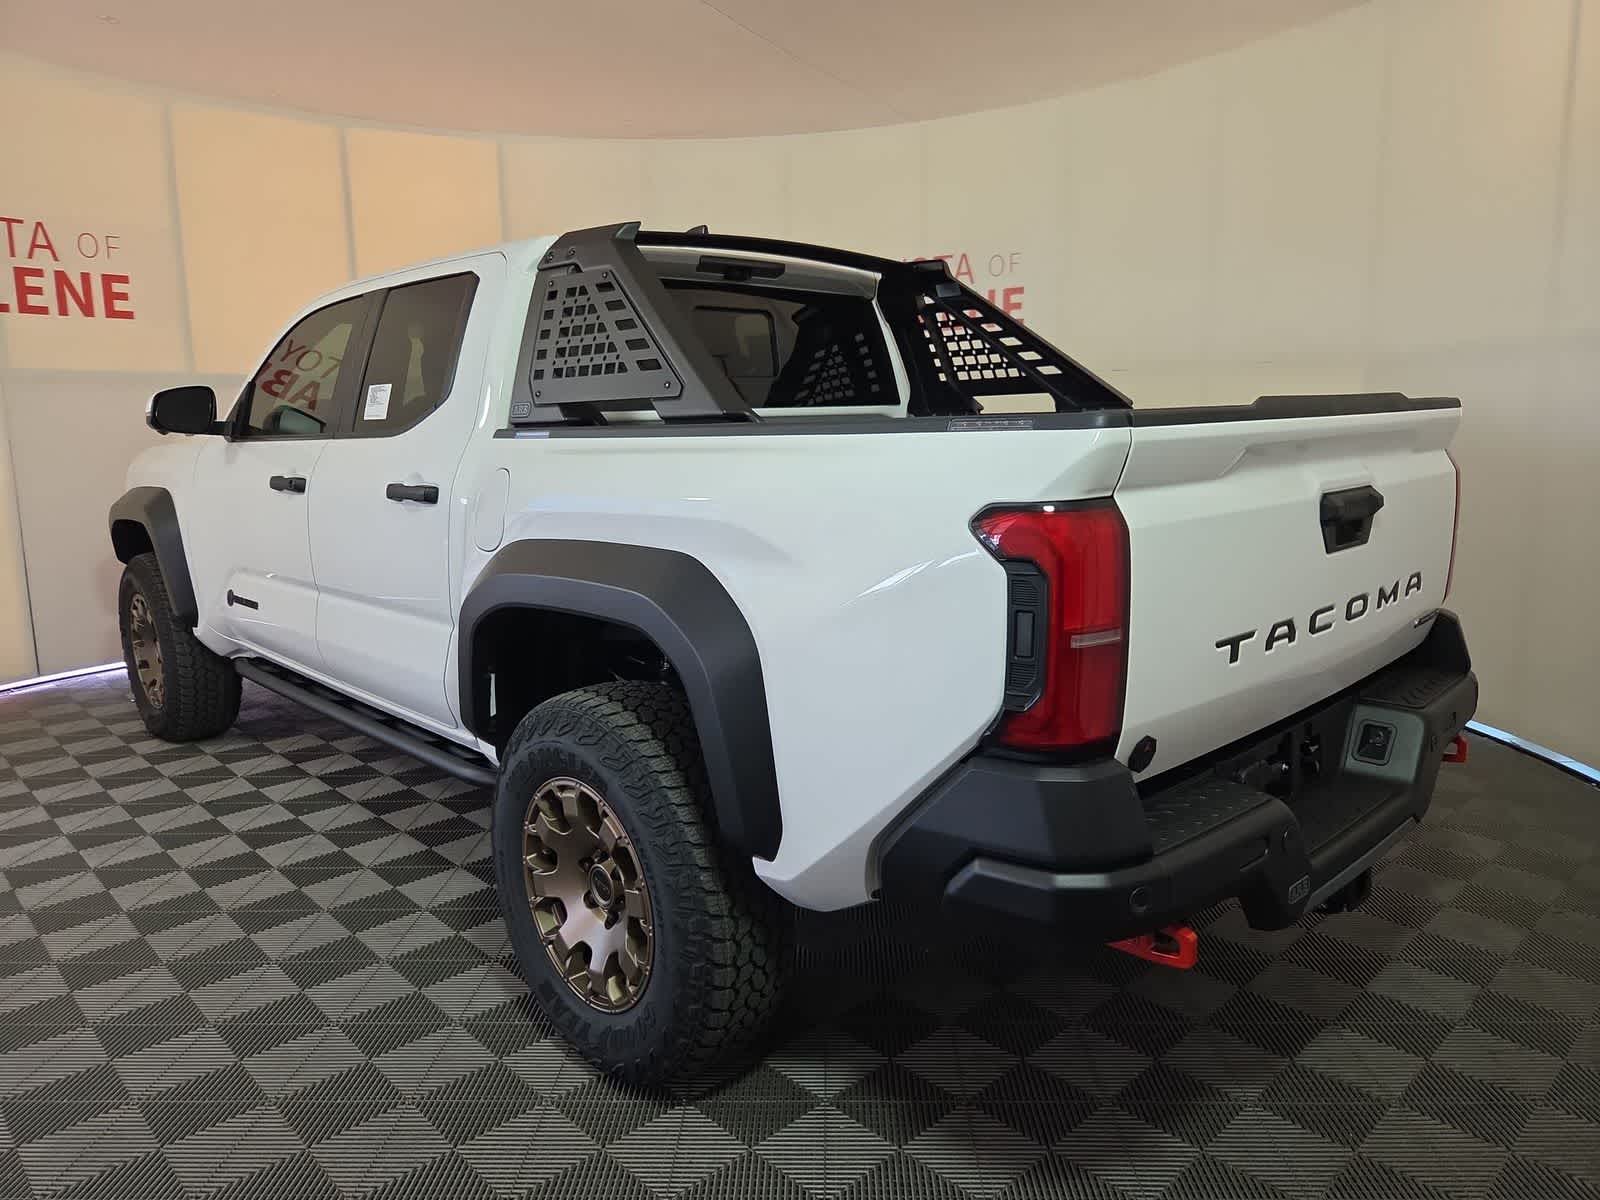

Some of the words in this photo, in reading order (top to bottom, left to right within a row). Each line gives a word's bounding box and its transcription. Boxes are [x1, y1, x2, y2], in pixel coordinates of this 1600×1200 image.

[77, 232, 121, 259] OF
[988, 252, 1022, 277] OF
[0, 266, 135, 320] ENE
[1214, 571, 1422, 665] TACOMA
